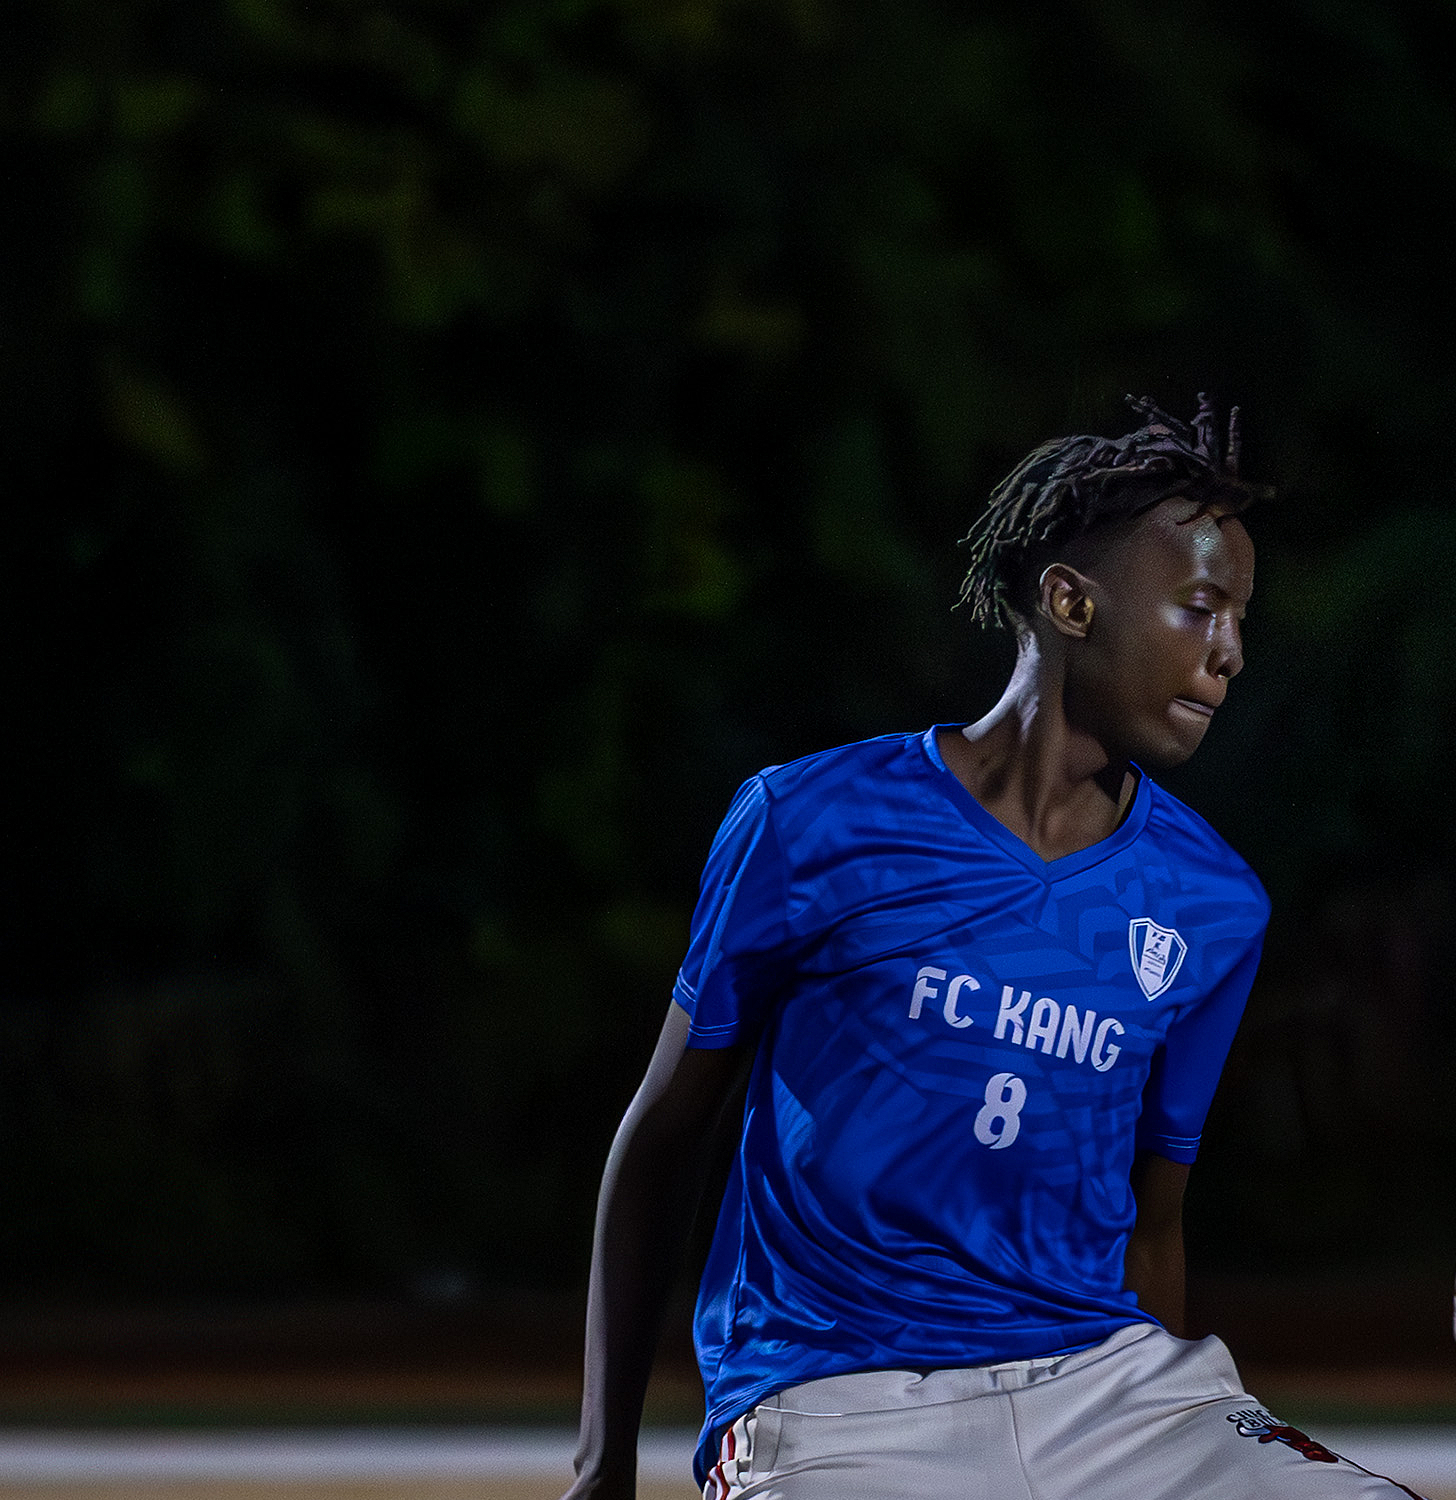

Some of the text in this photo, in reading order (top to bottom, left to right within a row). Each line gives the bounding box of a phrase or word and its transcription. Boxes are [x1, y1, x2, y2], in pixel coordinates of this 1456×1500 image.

[908, 966, 1126, 1073] FC KANG
[973, 1072, 1028, 1150] 8
